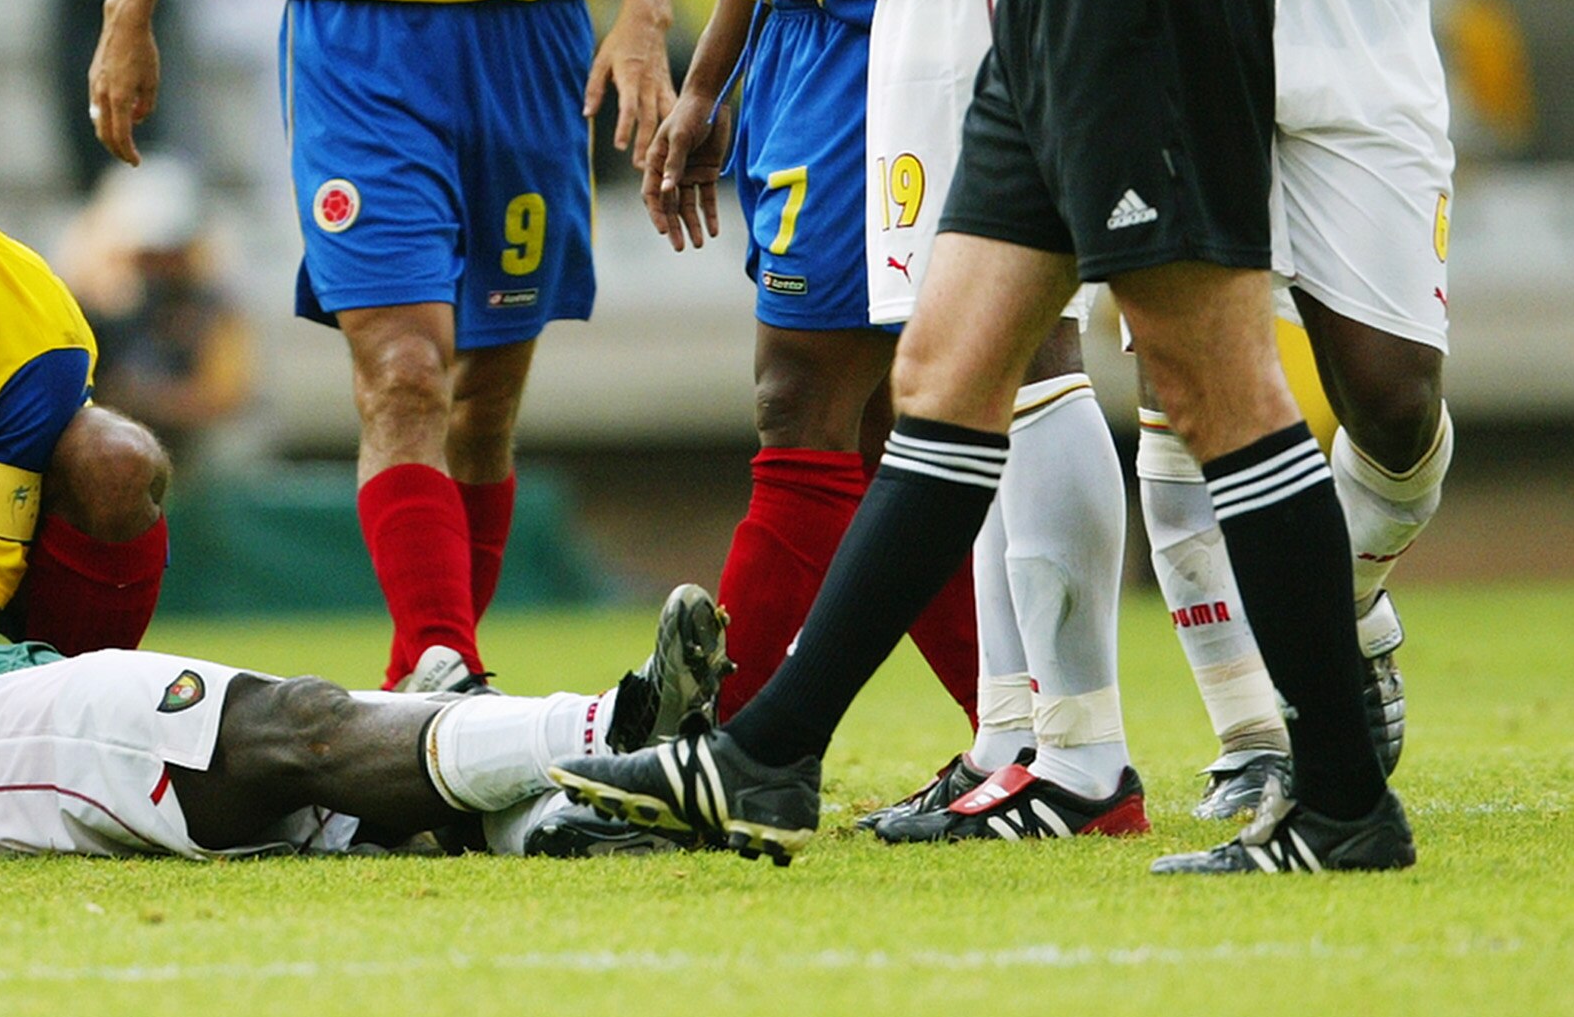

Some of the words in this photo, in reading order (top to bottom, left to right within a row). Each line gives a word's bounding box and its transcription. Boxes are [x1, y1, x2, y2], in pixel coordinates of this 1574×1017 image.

[768, 165, 808, 255] 7
[877, 152, 925, 231] 19
[501, 193, 546, 276] 9
